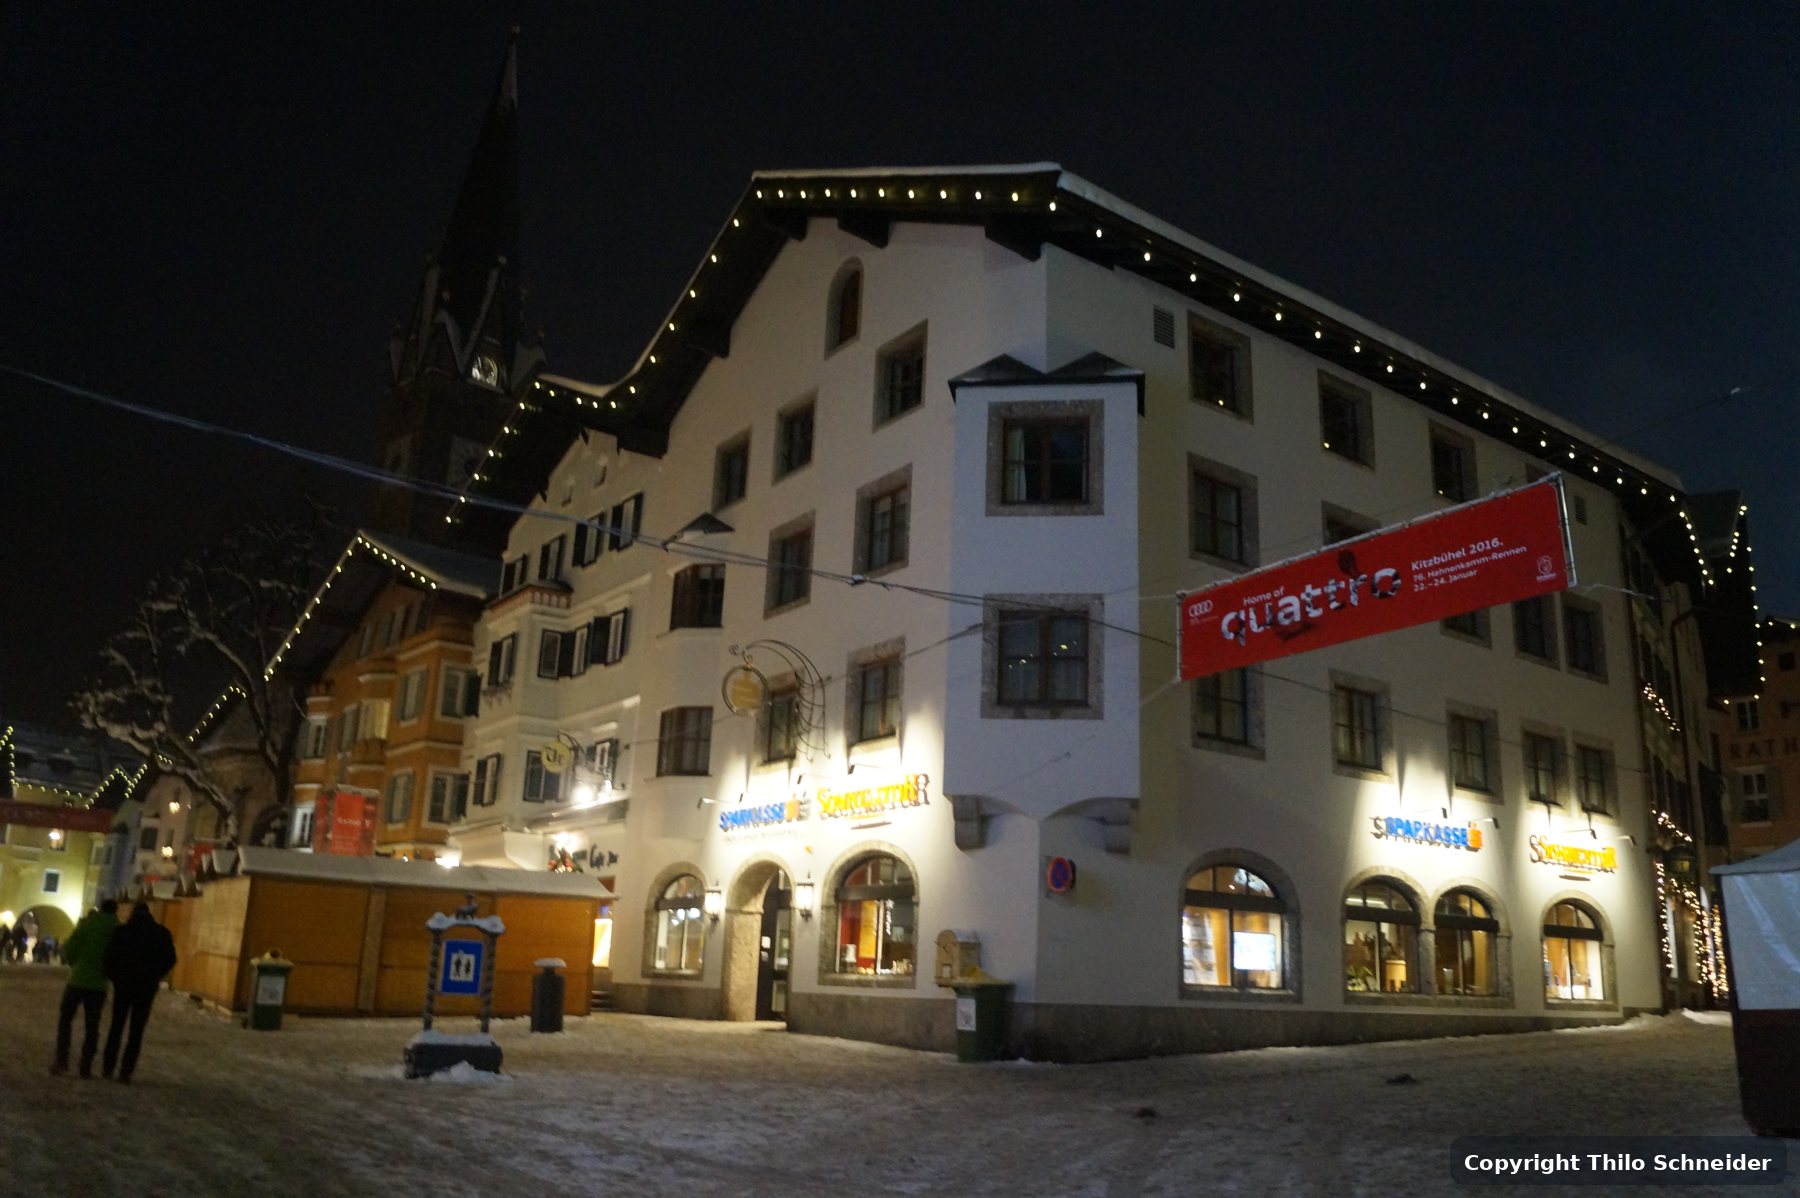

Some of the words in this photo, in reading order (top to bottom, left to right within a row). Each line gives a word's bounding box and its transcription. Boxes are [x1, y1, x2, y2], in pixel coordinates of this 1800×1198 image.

[1411, 548, 1466, 571] Kitzbühel
[1469, 537, 1504, 555] 2016.
[1427, 545, 1527, 577] Hahnenkamm-Rennen
[1449, 569, 1478, 584] Januar
[1221, 567, 1401, 647] quattro
[1243, 592, 1272, 606] Home
[1273, 586, 1285, 598] of
[1378, 815, 1469, 848] SPARKASSE
